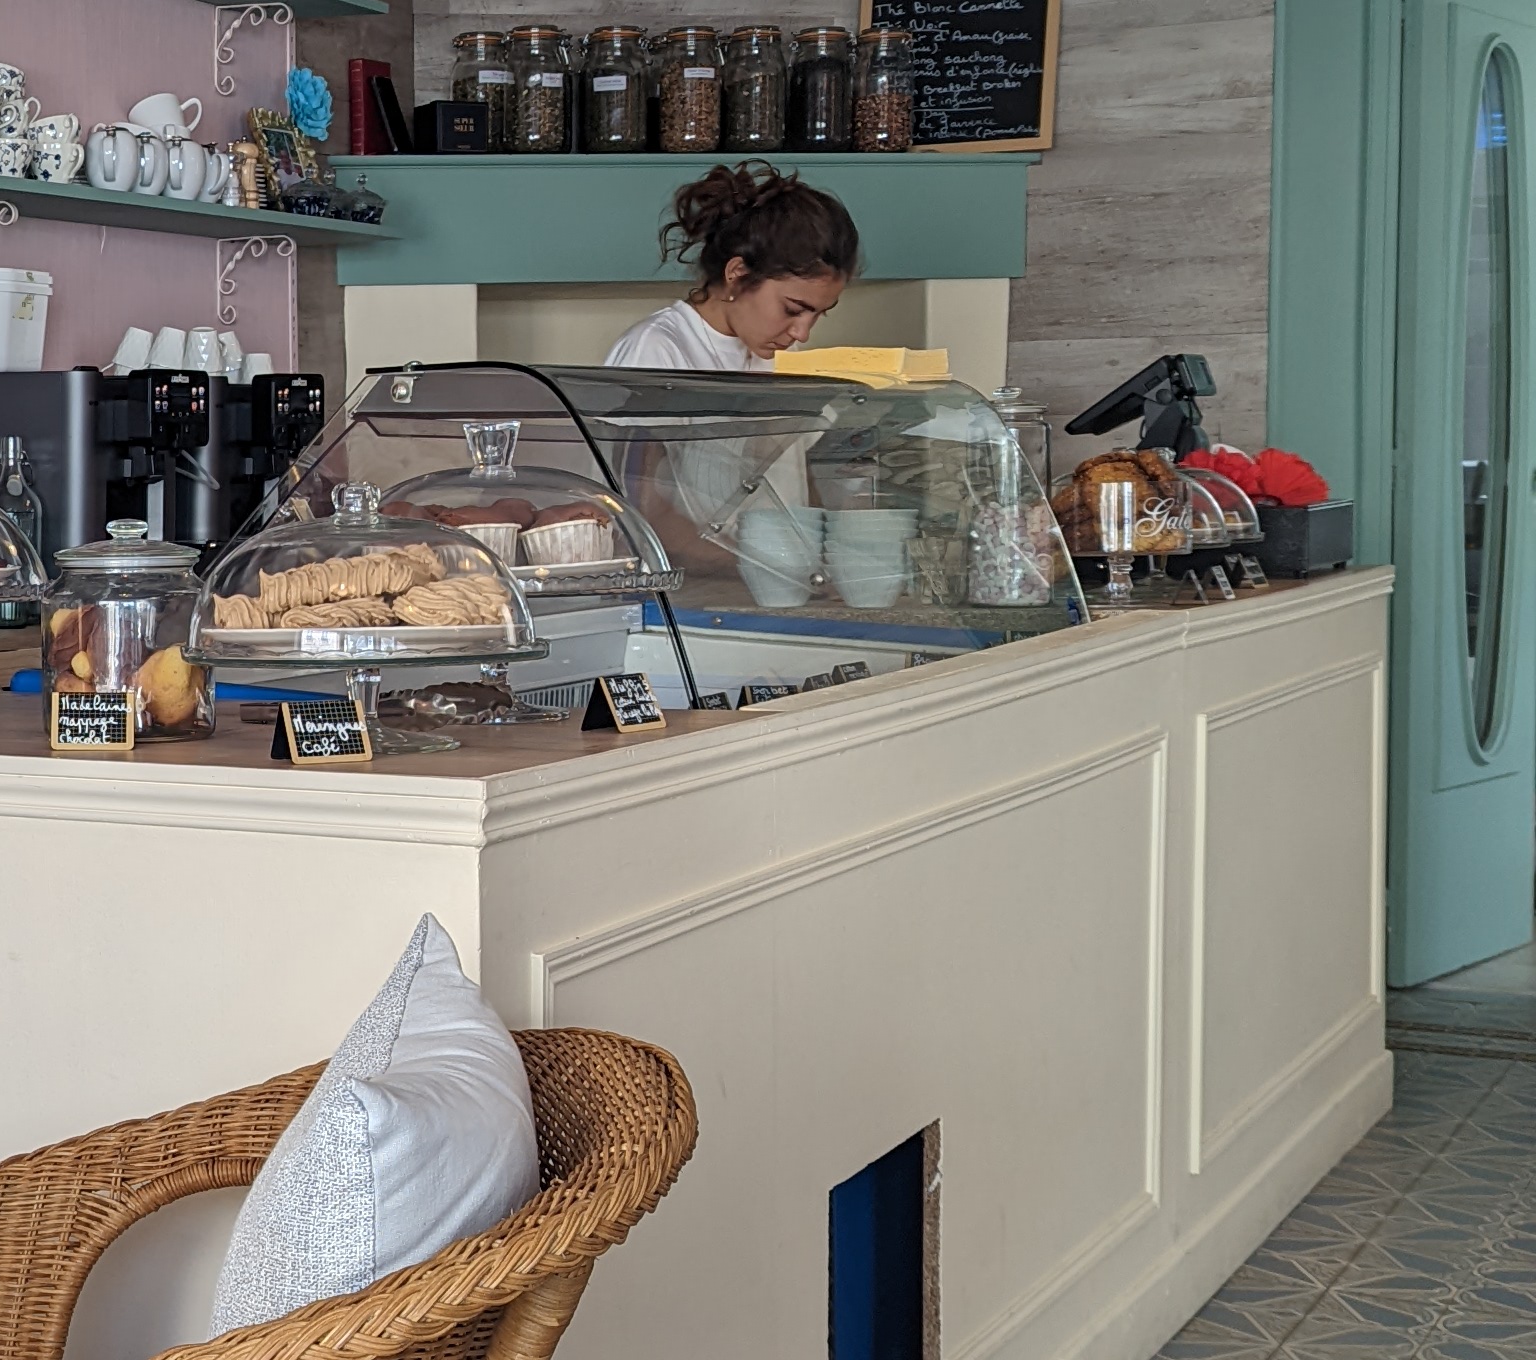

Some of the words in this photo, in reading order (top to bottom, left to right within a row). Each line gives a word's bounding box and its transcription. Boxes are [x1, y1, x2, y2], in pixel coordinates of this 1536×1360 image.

[875, 3, 906, 18] Thé
[59, 716, 118, 734] nappage
[59, 728, 111, 745] chocolat
[302, 736, 340, 756] Café
